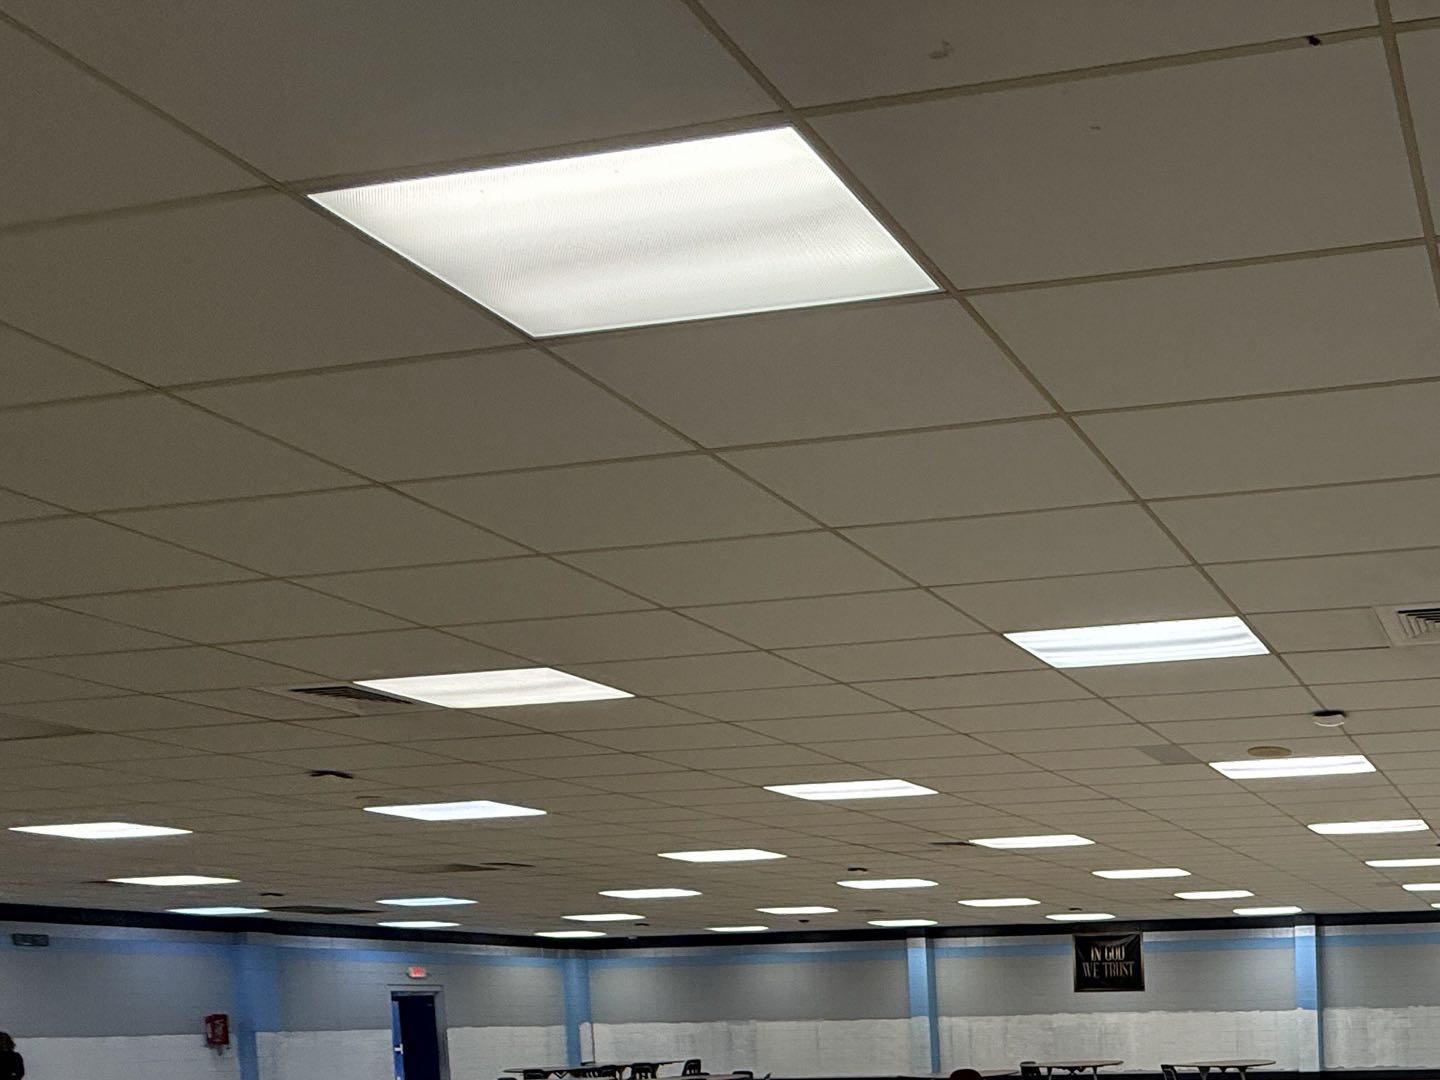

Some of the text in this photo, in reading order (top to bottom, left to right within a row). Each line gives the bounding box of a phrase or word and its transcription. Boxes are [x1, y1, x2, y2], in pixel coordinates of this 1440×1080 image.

[1090, 944, 1125, 961] IN GOD
[1082, 961, 1135, 979] WE TRUST
